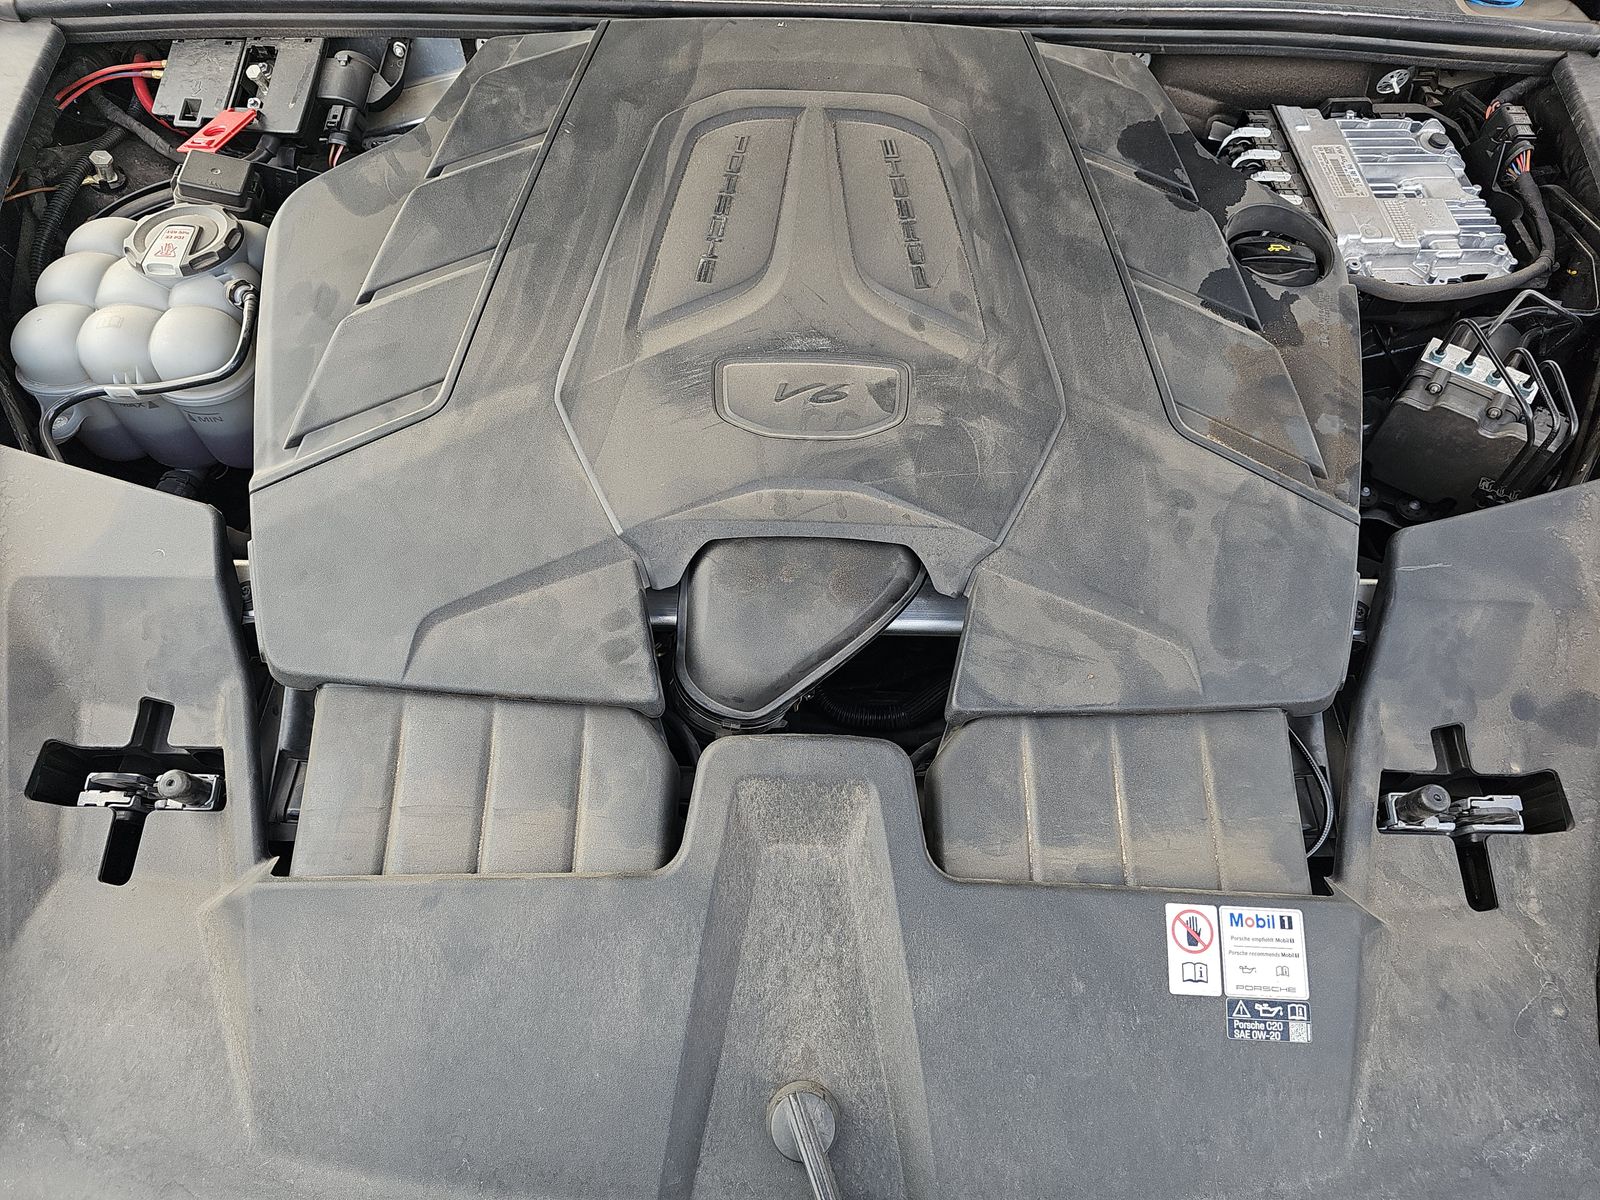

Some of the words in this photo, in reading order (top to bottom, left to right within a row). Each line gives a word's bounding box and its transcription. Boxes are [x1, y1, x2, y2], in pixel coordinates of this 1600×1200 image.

[694, 134, 750, 283] PORSCHE
[880, 138, 930, 289] PORSCHE
[774, 382, 853, 403] V6
[1229, 913, 1275, 929] Mobil
[1280, 915, 1293, 930] 1
[1234, 1020, 1265, 1031] Porsche
[1266, 1022, 1283, 1031] C20
[1234, 1031, 1251, 1039] SAE
[1252, 1031, 1281, 1040] 0W-20
